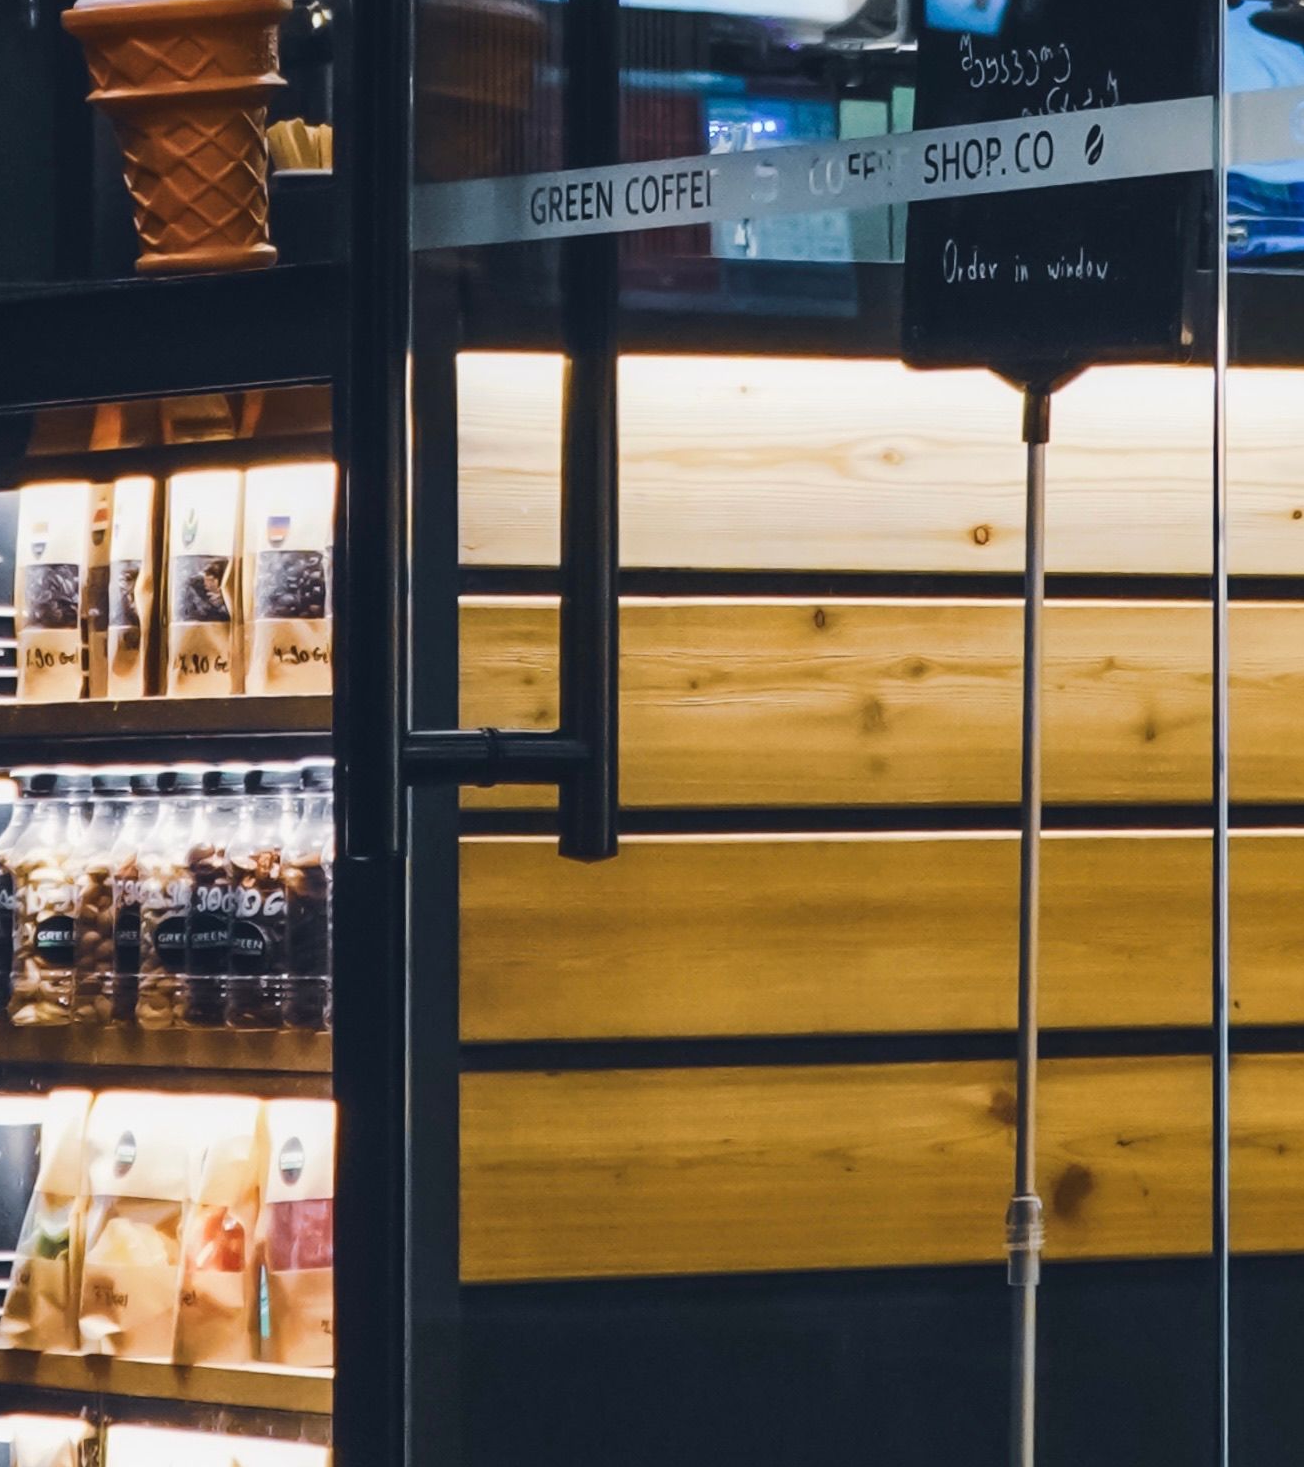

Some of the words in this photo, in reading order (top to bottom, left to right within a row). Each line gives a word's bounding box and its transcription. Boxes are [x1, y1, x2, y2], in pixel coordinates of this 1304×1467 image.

[530, 180, 613, 225] GREEN
[943, 239, 998, 283] Order
[1014, 254, 1029, 282] in
[1046, 246, 1109, 281] window
